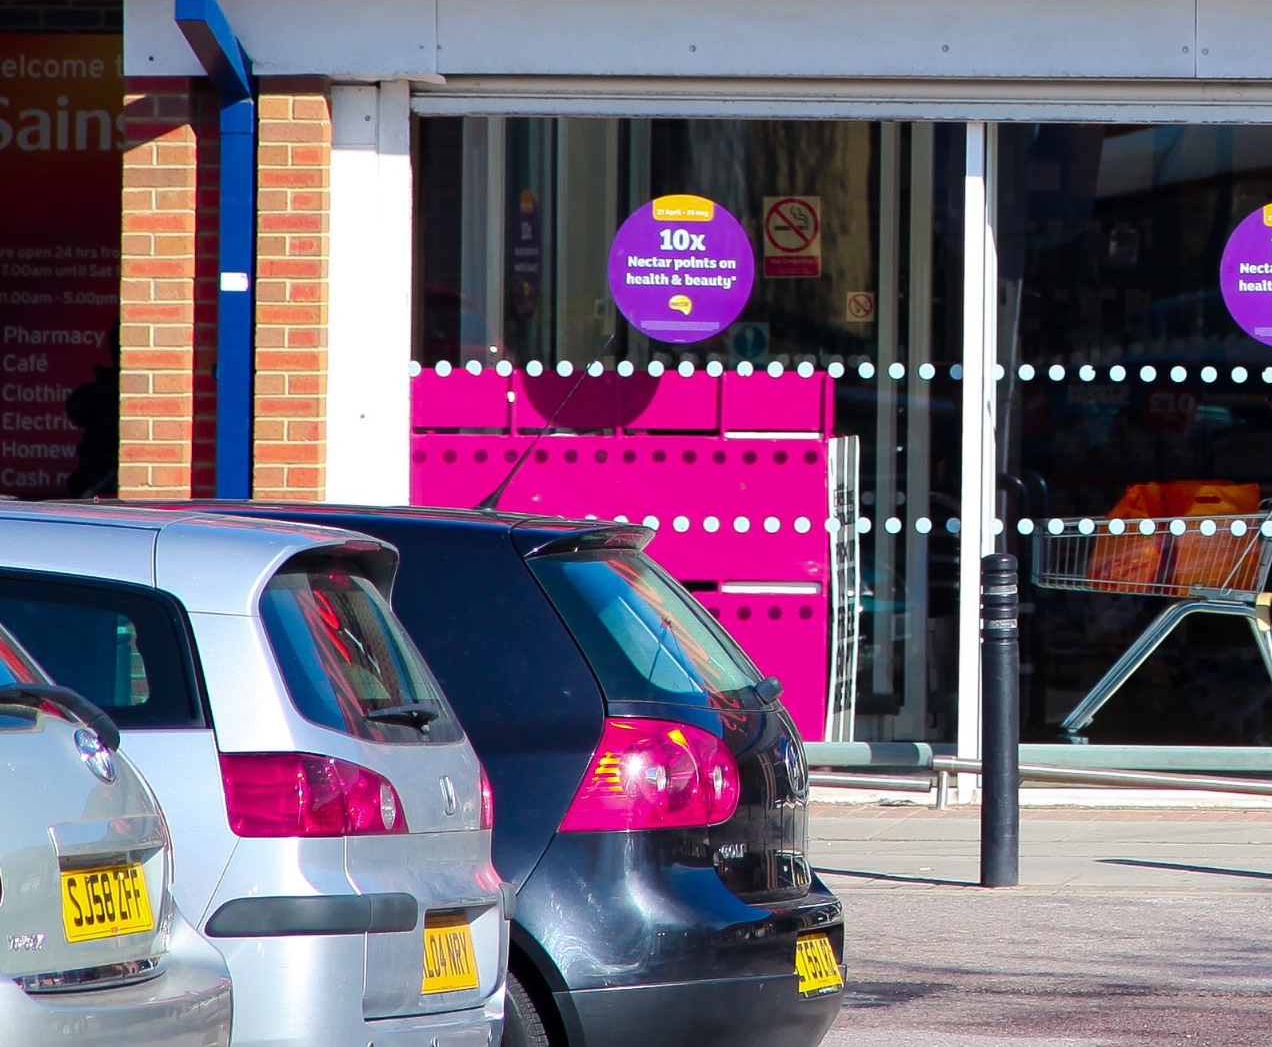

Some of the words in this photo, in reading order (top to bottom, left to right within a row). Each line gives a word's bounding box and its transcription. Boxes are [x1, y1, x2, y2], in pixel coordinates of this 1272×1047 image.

[0, 54, 105, 78] elcome
[659, 228, 706, 251] 10x
[17, 247, 52, 262] open
[54, 246, 72, 258] 24
[76, 247, 98, 258] hrs
[100, 247, 120, 258] fro
[627, 255, 673, 268] Nectar
[673, 256, 717, 271] points
[718, 259, 737, 269] on
[626, 272, 670, 285] health
[670, 274, 682, 286] &
[3, 326, 107, 345] Pharmacy
[2, 353, 48, 373] Café
[2, 383, 73, 402] Clothin
[1, 412, 82, 430] Electric
[1, 441, 77, 459] Homew
[1, 469, 50, 487] Cash
[67, 873, 116, 928] SJ58
